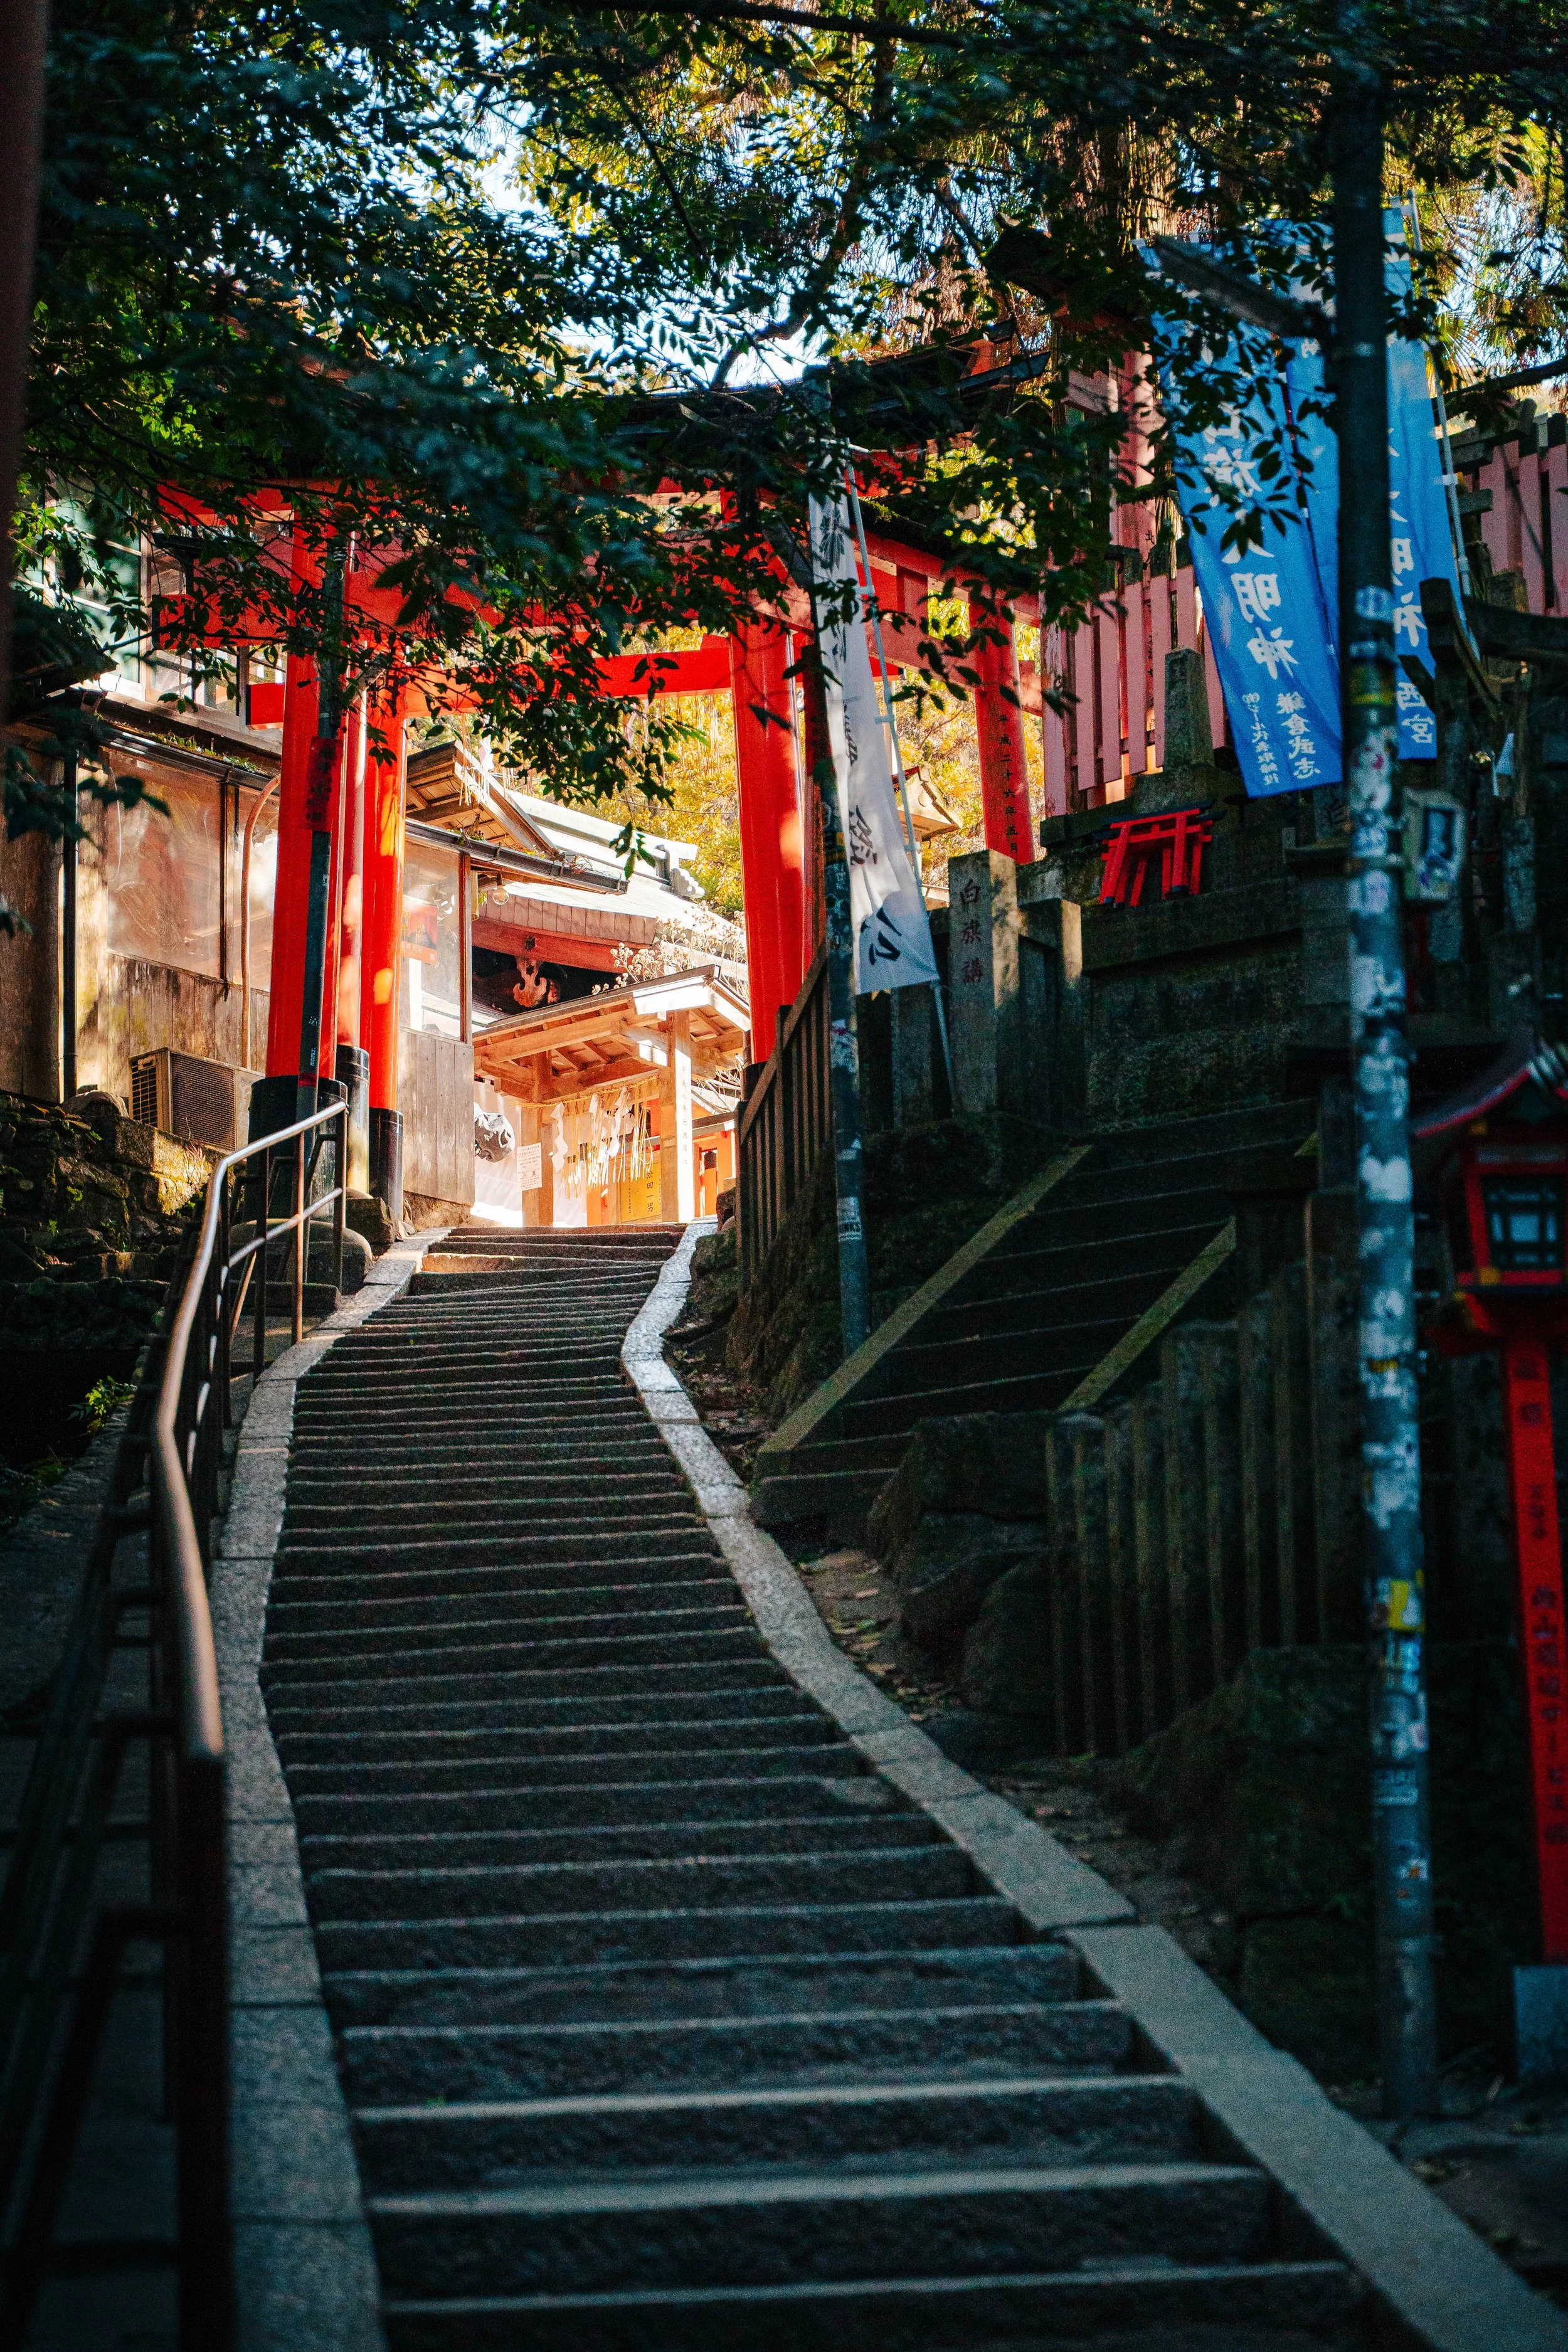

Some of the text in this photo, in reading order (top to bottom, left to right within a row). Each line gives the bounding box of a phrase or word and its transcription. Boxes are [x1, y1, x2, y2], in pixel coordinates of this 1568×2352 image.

[960, 879, 984, 983] 白旗講
[646, 1170, 654, 1212] 松田一男
